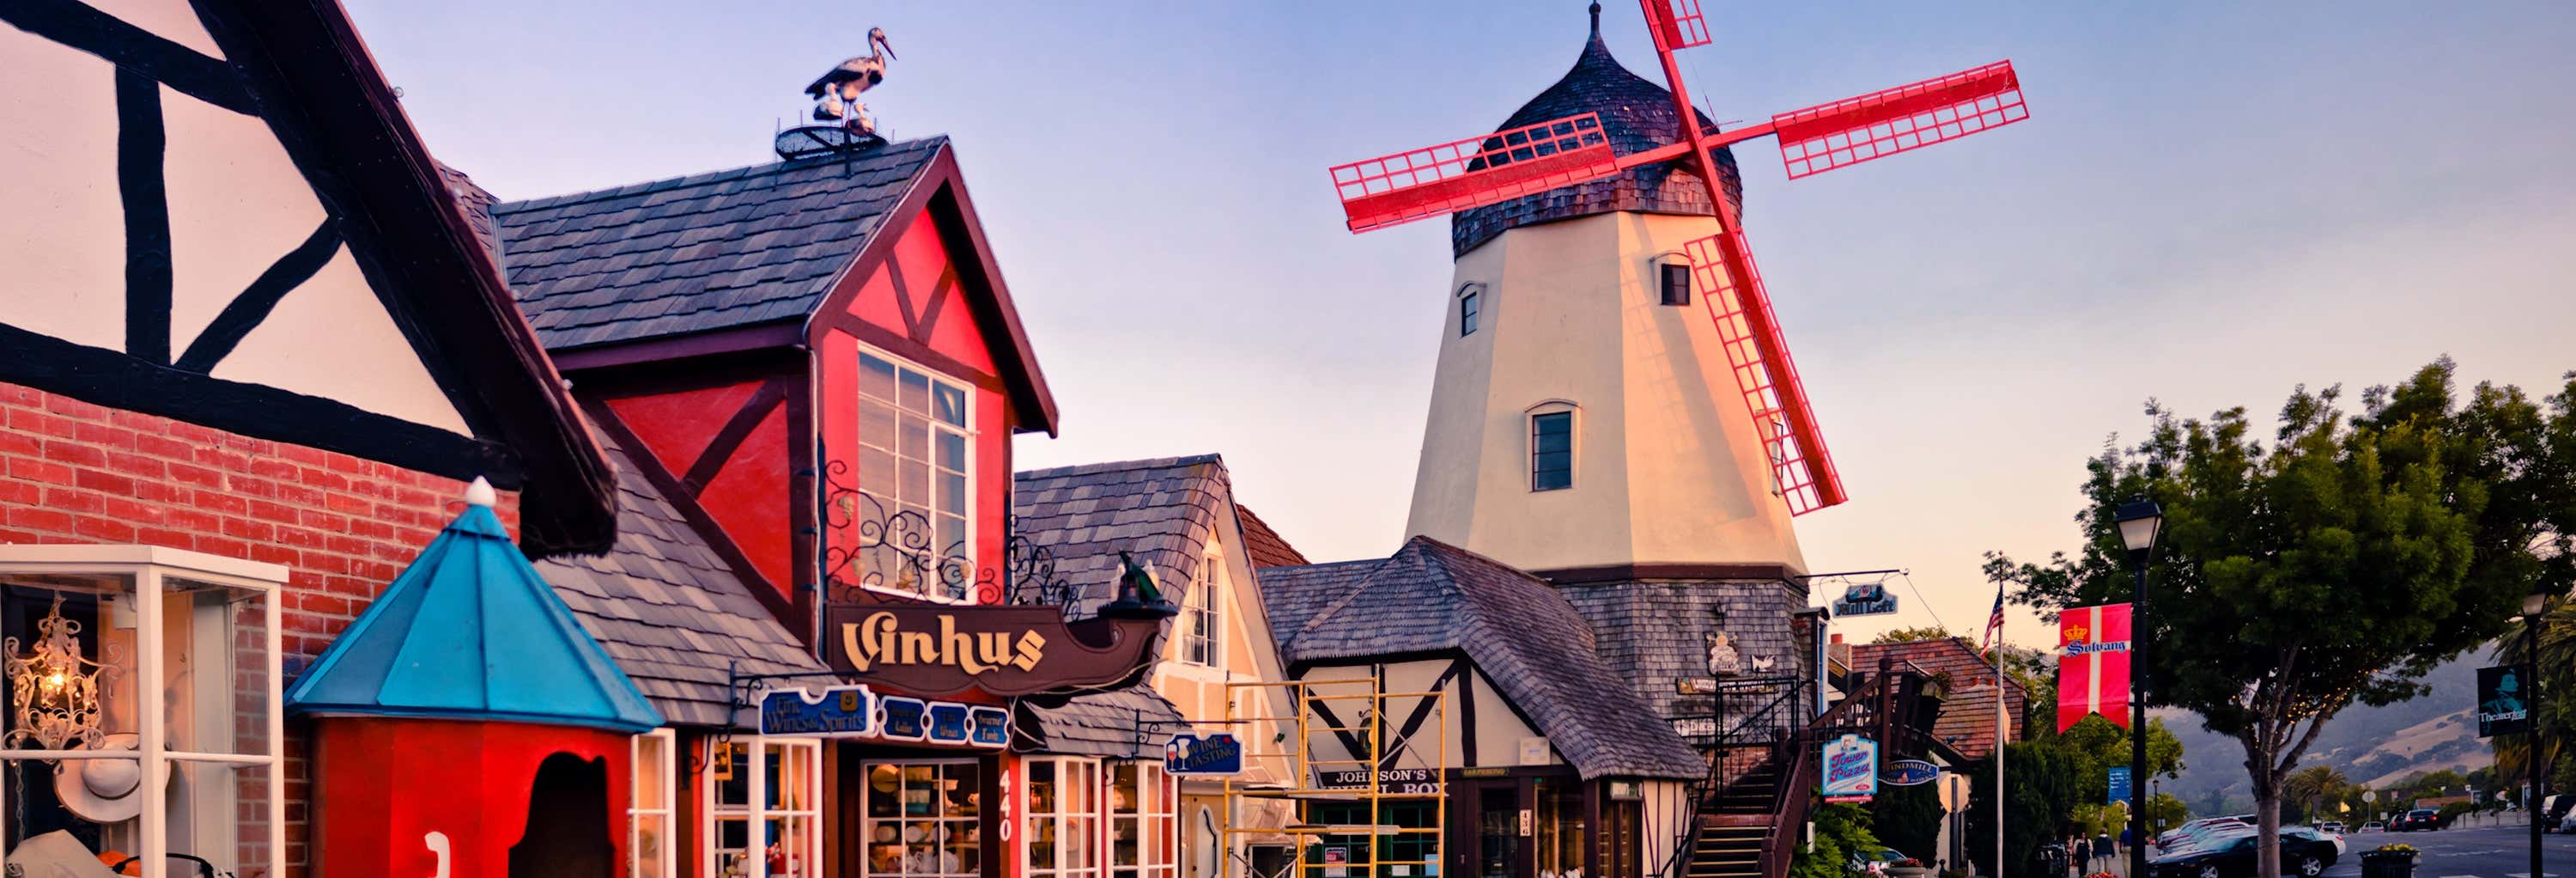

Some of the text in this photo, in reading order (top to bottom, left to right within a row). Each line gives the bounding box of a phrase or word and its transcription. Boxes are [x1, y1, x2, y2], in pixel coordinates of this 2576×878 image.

[1867, 600, 1895, 613] Loft
[841, 611, 1047, 676] Vinhus
[2065, 639, 2125, 658] Solvang
[1186, 736, 1223, 755] WINE
[1188, 747, 1236, 768] TASTING
[1832, 751, 1868, 768] Tower
[1830, 763, 1870, 783] Pizza
[1889, 762, 1932, 773] INDMILL
[999, 769, 1012, 842] 440
